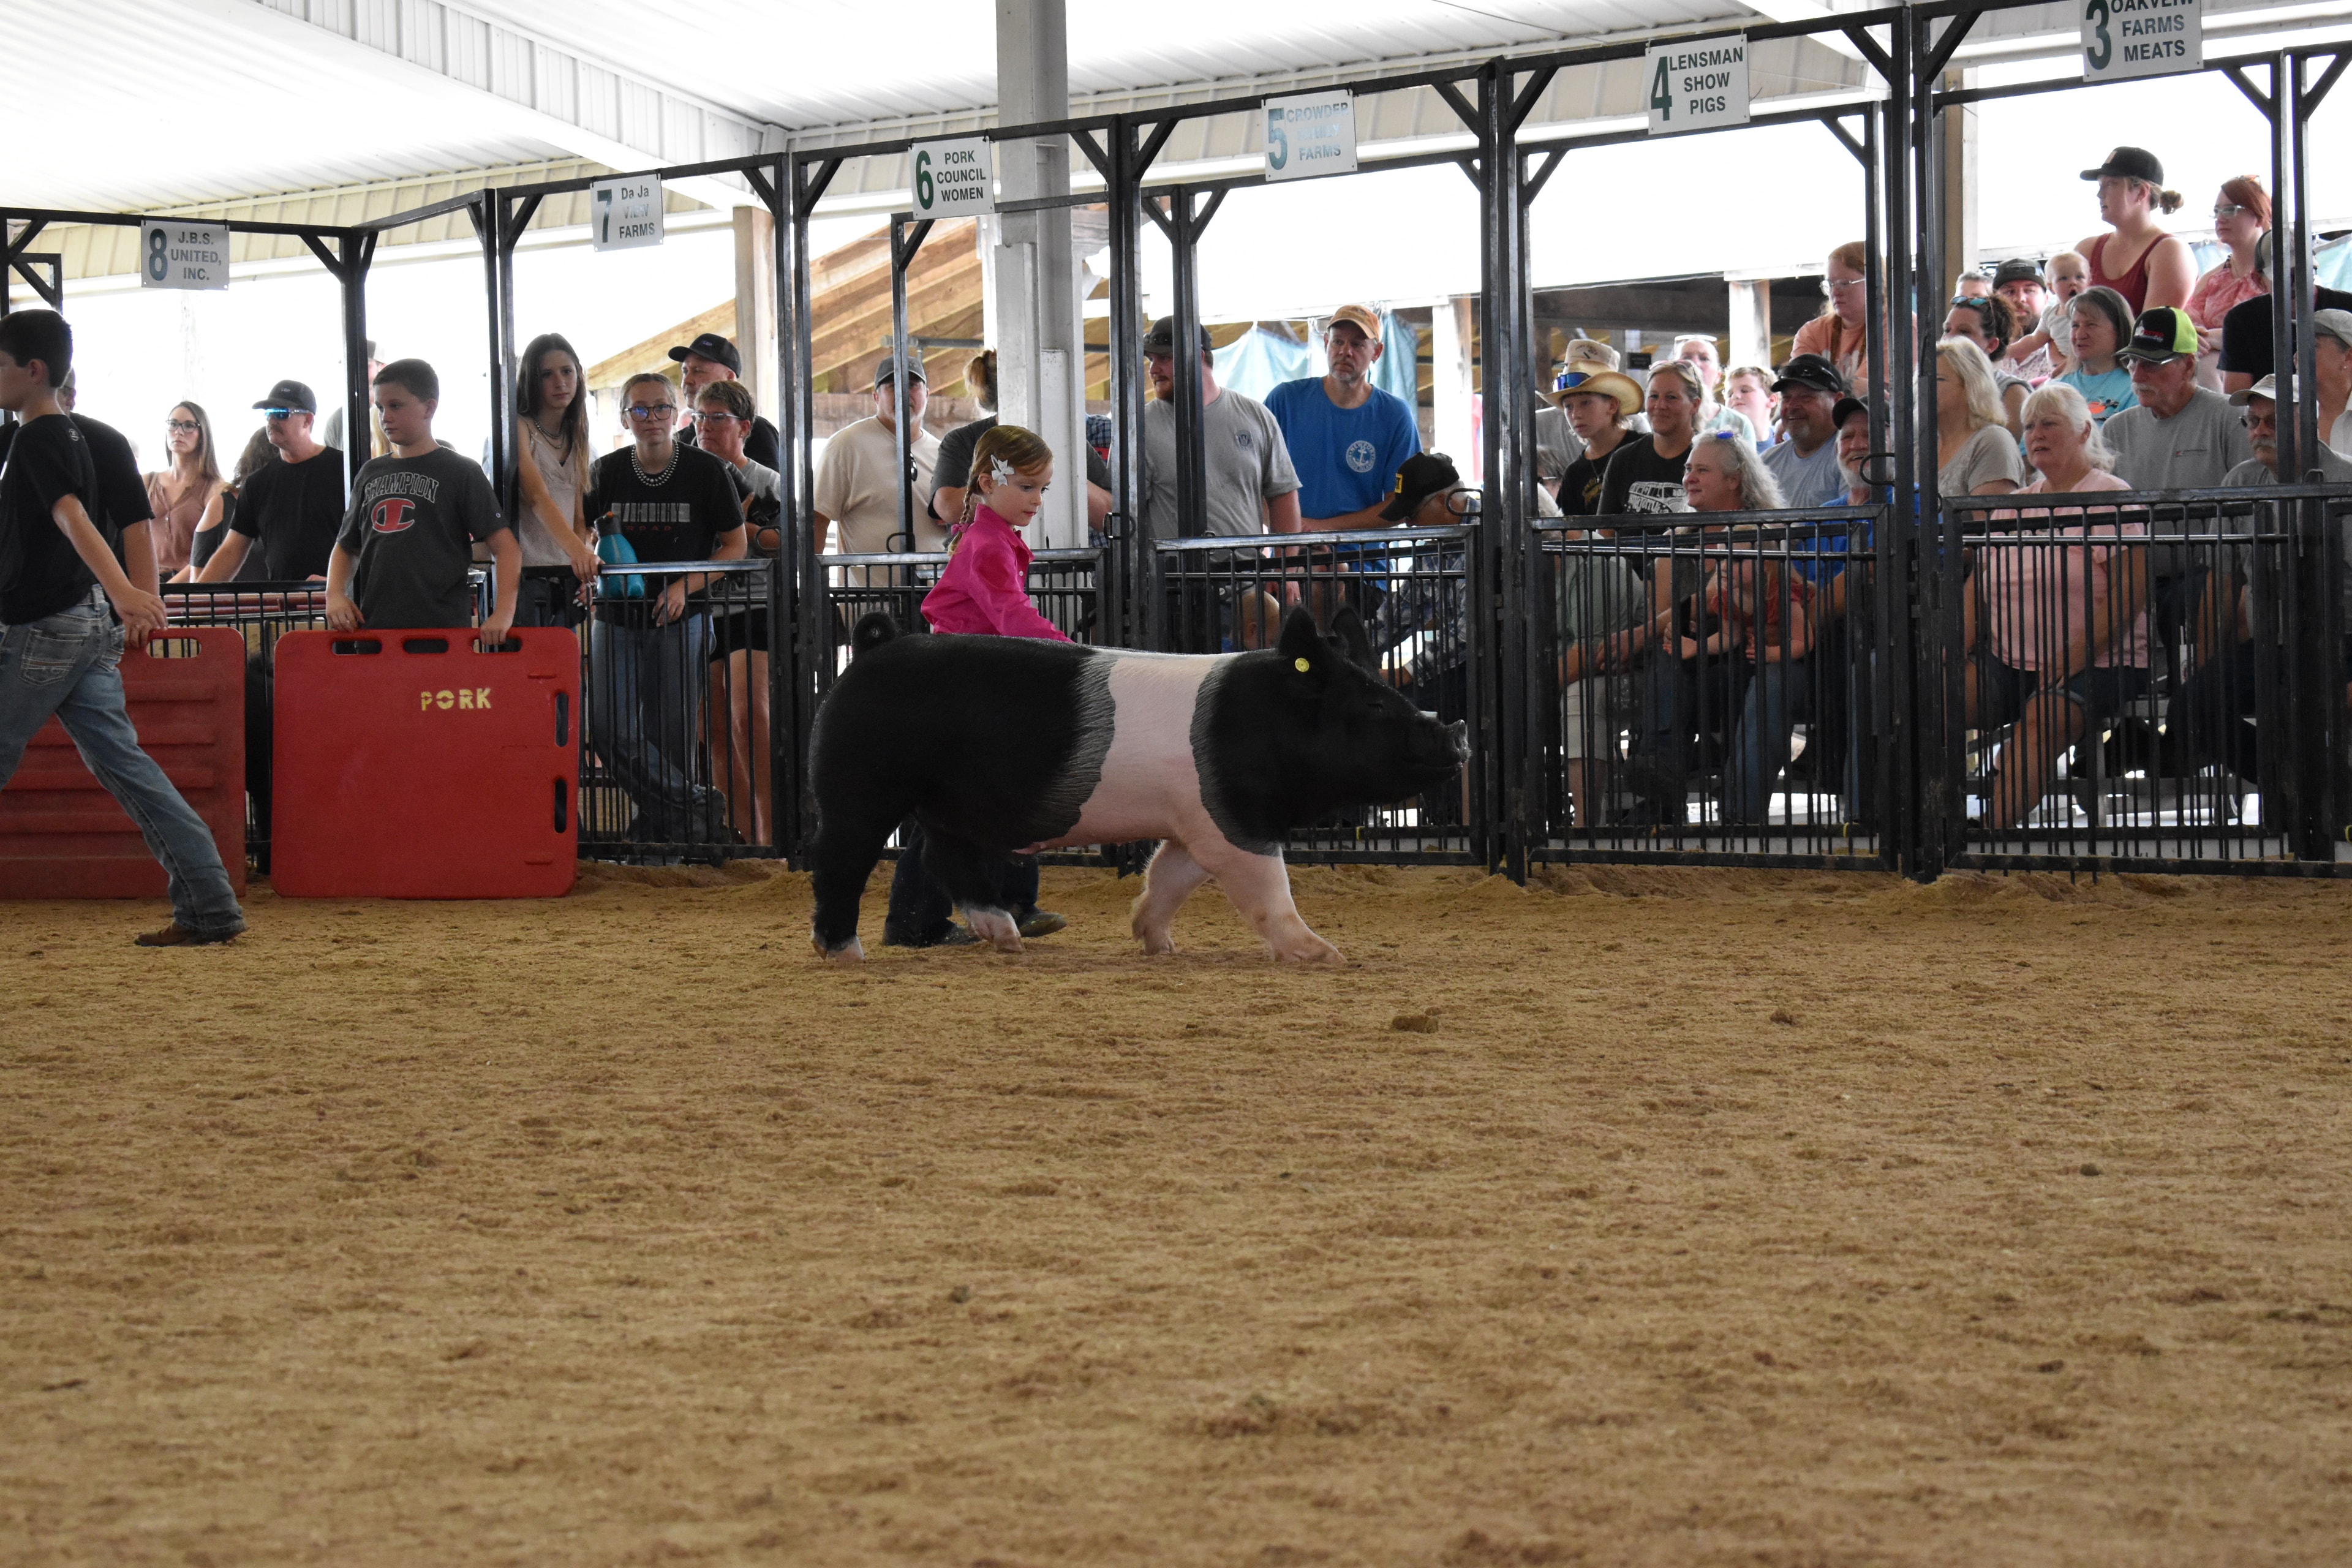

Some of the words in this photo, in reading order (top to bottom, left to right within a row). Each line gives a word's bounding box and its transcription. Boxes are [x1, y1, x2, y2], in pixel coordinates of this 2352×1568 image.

[2111, 0, 2193, 13] OAKV
[2086, 0, 2111, 70] 3
[2122, 14, 2185, 37] FARMS
[1669, 47, 1743, 71] LENSMAN
[2124, 40, 2185, 62] MEATS
[1651, 56, 1672, 121] 4
[1684, 72, 1730, 92] SHOW
[1286, 102, 1349, 123] CROWDER
[1690, 96, 1725, 115] PIGS
[1268, 107, 1287, 170] 5
[944, 150, 975, 165] PORK
[1299, 145, 1341, 160] FARMS
[916, 150, 934, 210] 6
[937, 168, 986, 184] COUNCIL
[621, 187, 634, 200] Da
[637, 185, 649, 198] Ja
[941, 186, 984, 202] WOMEN
[597, 189, 612, 243] 7
[178, 231, 214, 245] J.B.S.
[619, 222, 655, 239] FARMS
[149, 228, 168, 281] 8
[171, 249, 222, 266] UNITED,
[184, 268, 209, 281] INC.
[421, 687, 492, 711] PORK
